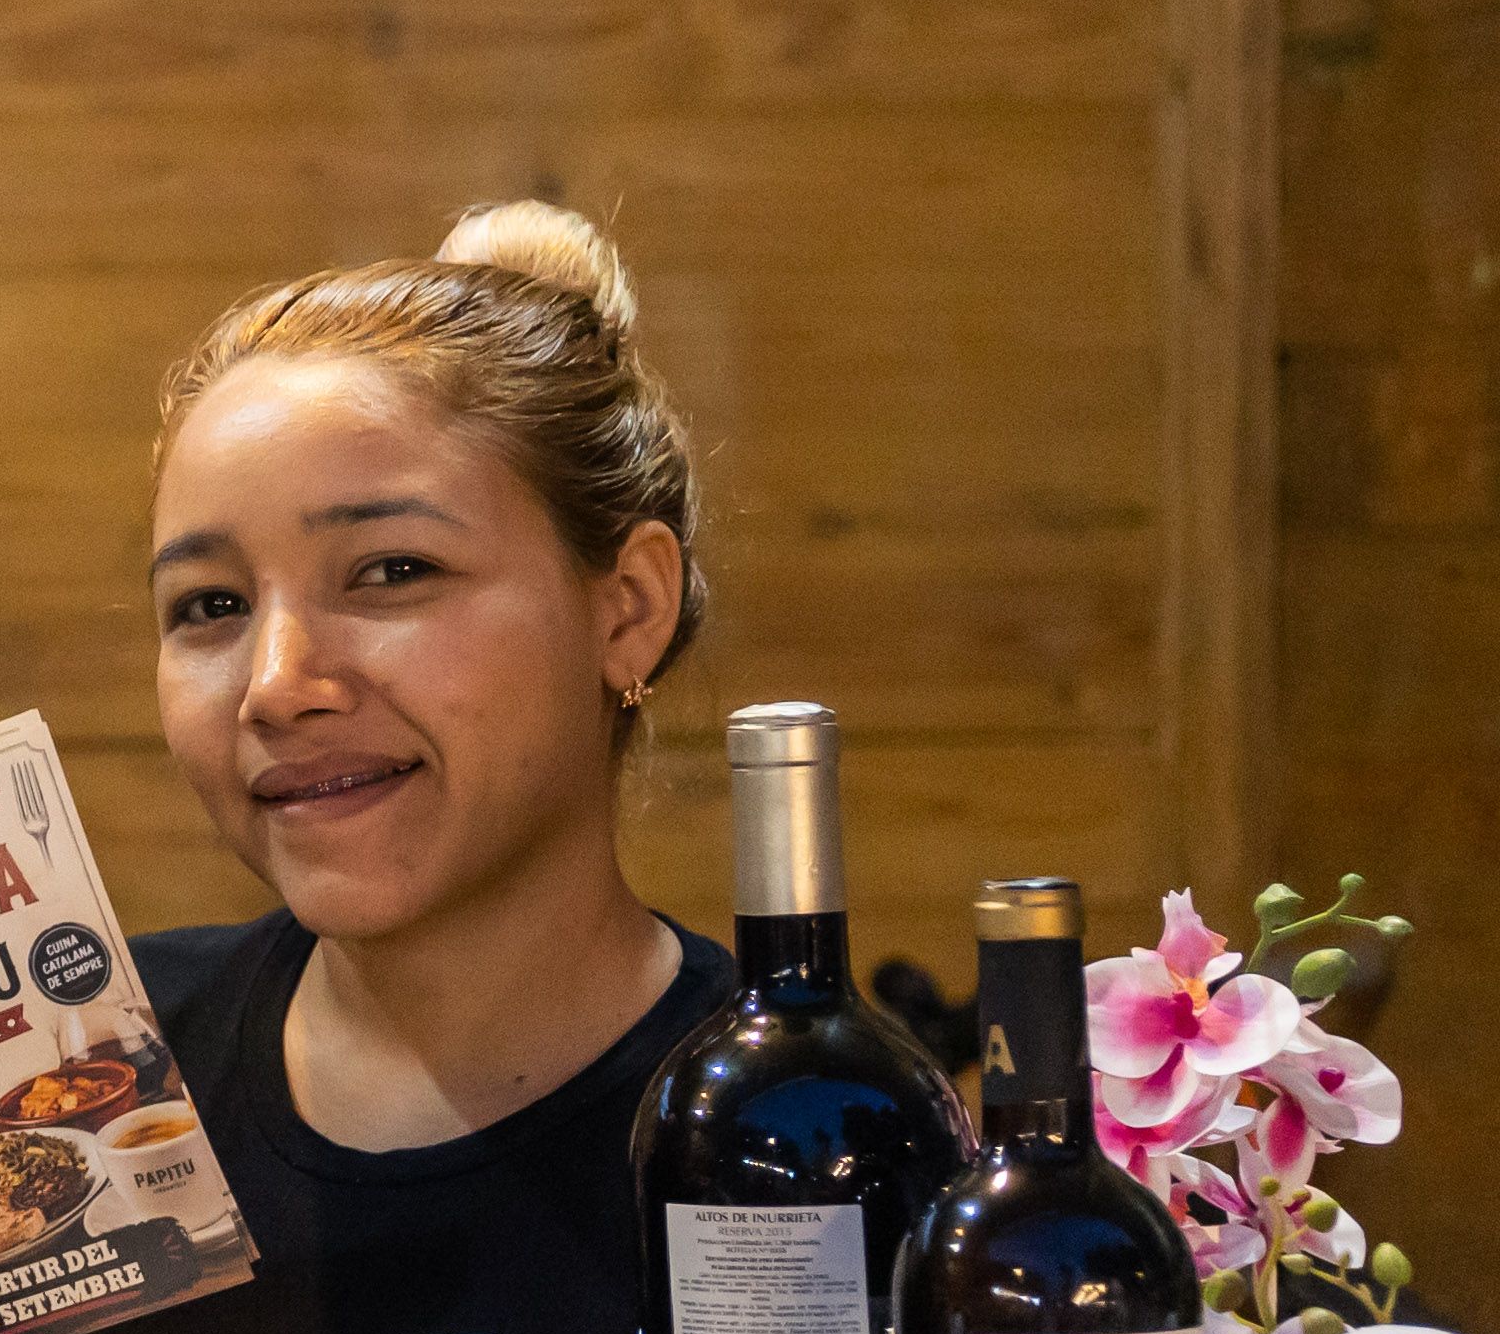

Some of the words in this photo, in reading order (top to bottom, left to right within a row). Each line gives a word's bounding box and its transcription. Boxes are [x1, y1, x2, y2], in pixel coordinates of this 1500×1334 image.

[42, 943, 95, 975] CATALANA
[46, 934, 79, 956] CUINA
[47, 974, 62, 990] DE
[63, 955, 104, 983] SEMPRE
[134, 1157, 195, 1188] PAPITU
[695, 1212, 728, 1222] ALTOS
[733, 1213, 748, 1223] DE
[753, 1213, 822, 1223] INURRIETA
[718, 1227, 762, 1236] RESERVA
[62, 1239, 119, 1275] DEL
[1, 1262, 145, 1326] SETEMBRE
